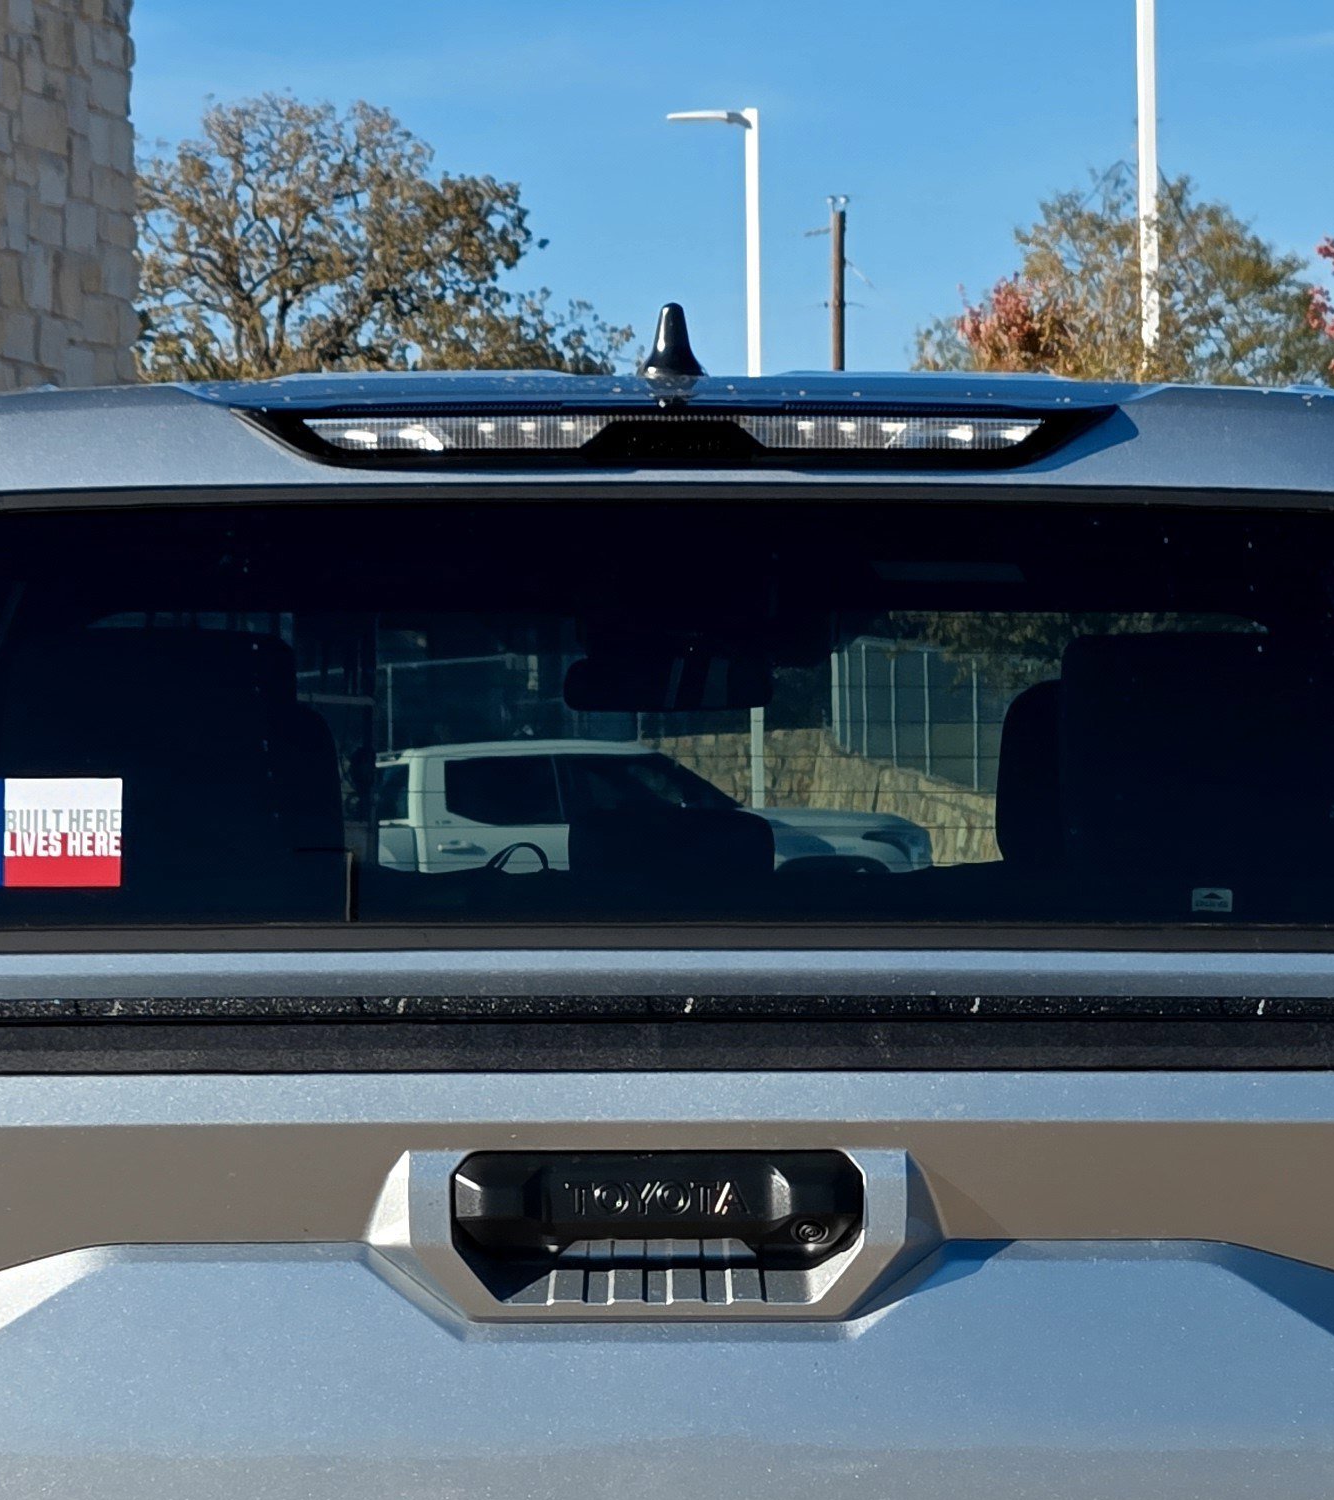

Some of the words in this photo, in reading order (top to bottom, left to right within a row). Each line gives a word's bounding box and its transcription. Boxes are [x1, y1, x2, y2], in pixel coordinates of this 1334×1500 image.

[5, 809, 63, 832] BUILT
[68, 809, 122, 832] HERE
[3, 832, 62, 857] LIVES
[67, 832, 122, 857] HERE
[564, 1180, 751, 1216] TOYOTA
